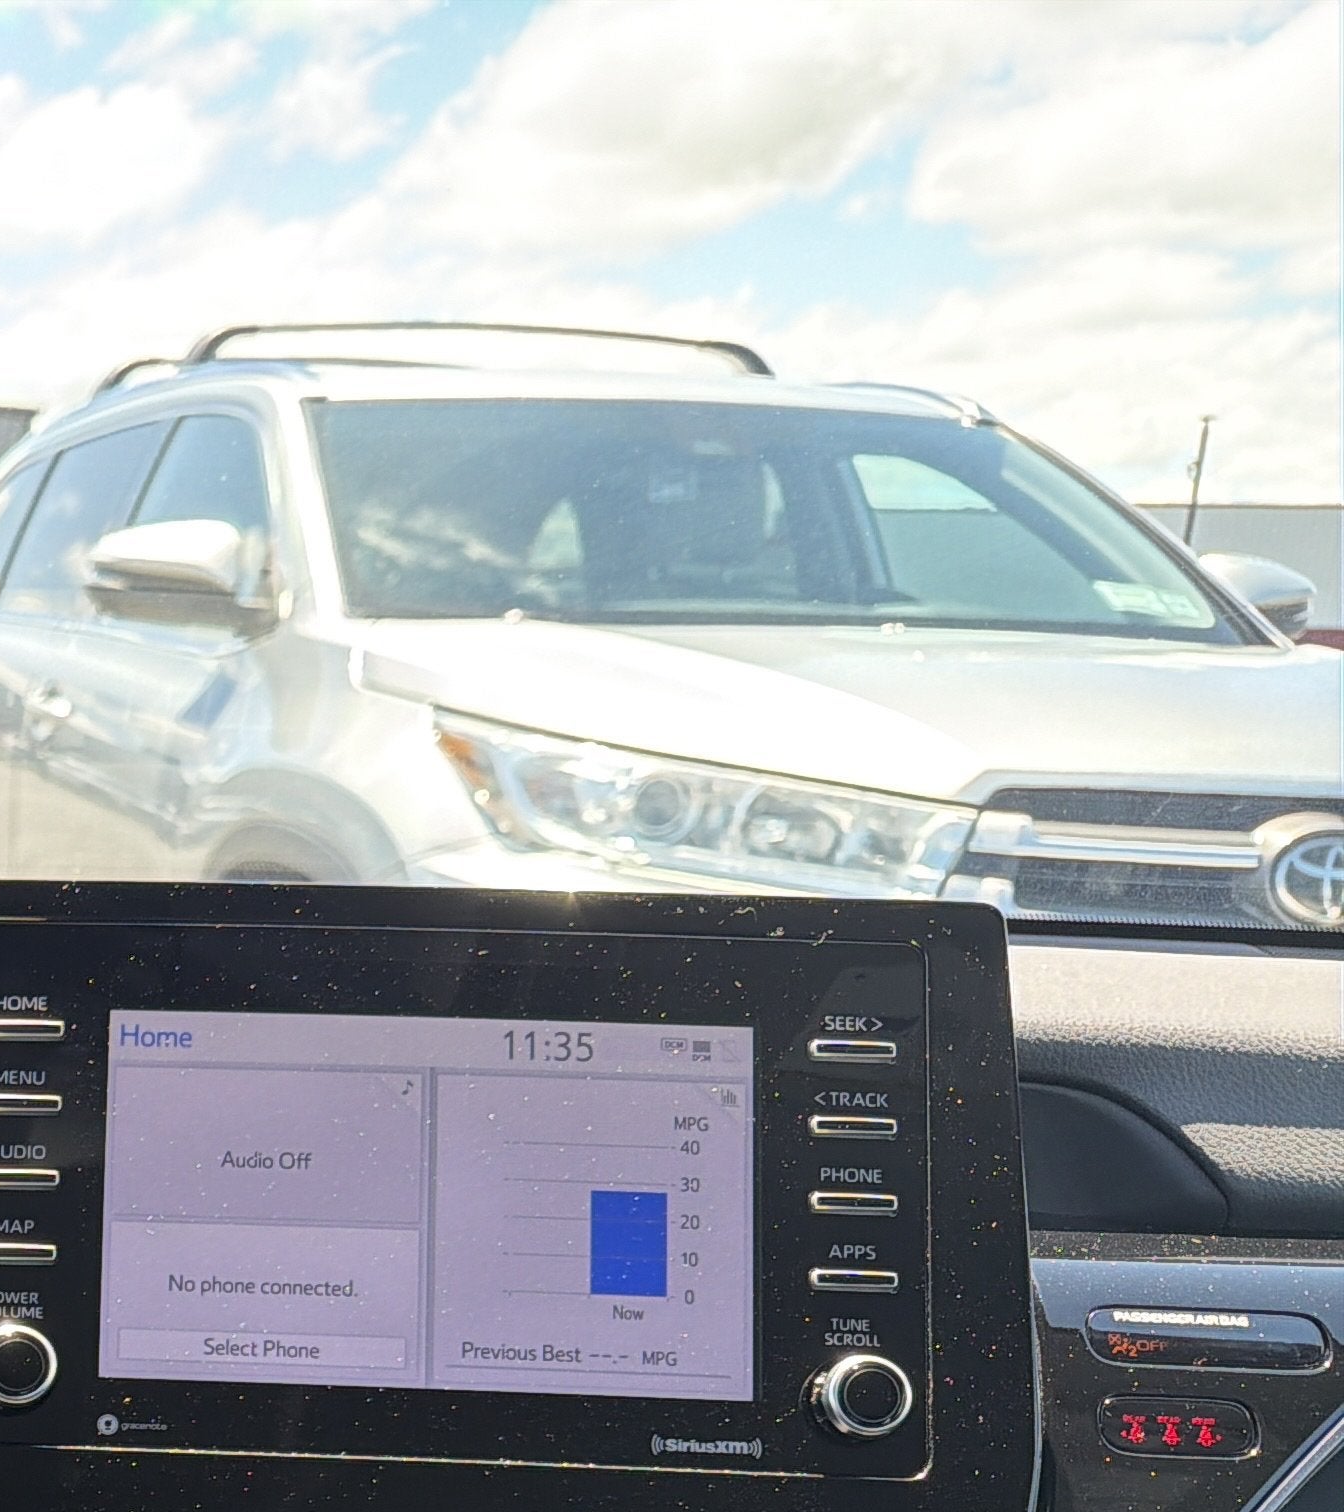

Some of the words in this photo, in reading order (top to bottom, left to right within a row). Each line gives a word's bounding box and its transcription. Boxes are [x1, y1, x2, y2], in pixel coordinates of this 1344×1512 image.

[824, 1017, 868, 1031] SEEK
[119, 1023, 193, 1048] Home
[502, 1030, 595, 1063] 11:35
[831, 1092, 889, 1108] TRACK
[674, 1116, 710, 1132] MPG
[680, 1140, 701, 1156] 40
[220, 1150, 274, 1170] Audio
[279, 1151, 312, 1171] Off
[820, 1168, 883, 1184] PHONE
[680, 1177, 701, 1193] 30
[680, 1214, 701, 1231] 20
[681, 1251, 699, 1268] 10
[828, 1245, 877, 1261] APPS
[168, 1274, 196, 1292] No
[200, 1276, 256, 1298] phone
[261, 1279, 359, 1298] connected.
[683, 1289, 695, 1306] 0
[612, 1305, 645, 1321] Now
[829, 1318, 870, 1332] TUNE
[824, 1332, 881, 1348] SCROLL
[203, 1339, 258, 1358] Select
[263, 1341, 320, 1360] Phone
[461, 1341, 538, 1362] Previous
[543, 1344, 582, 1363] Best
[641, 1350, 678, 1368] MPG
[121, 1421, 168, 1432] gracenote
